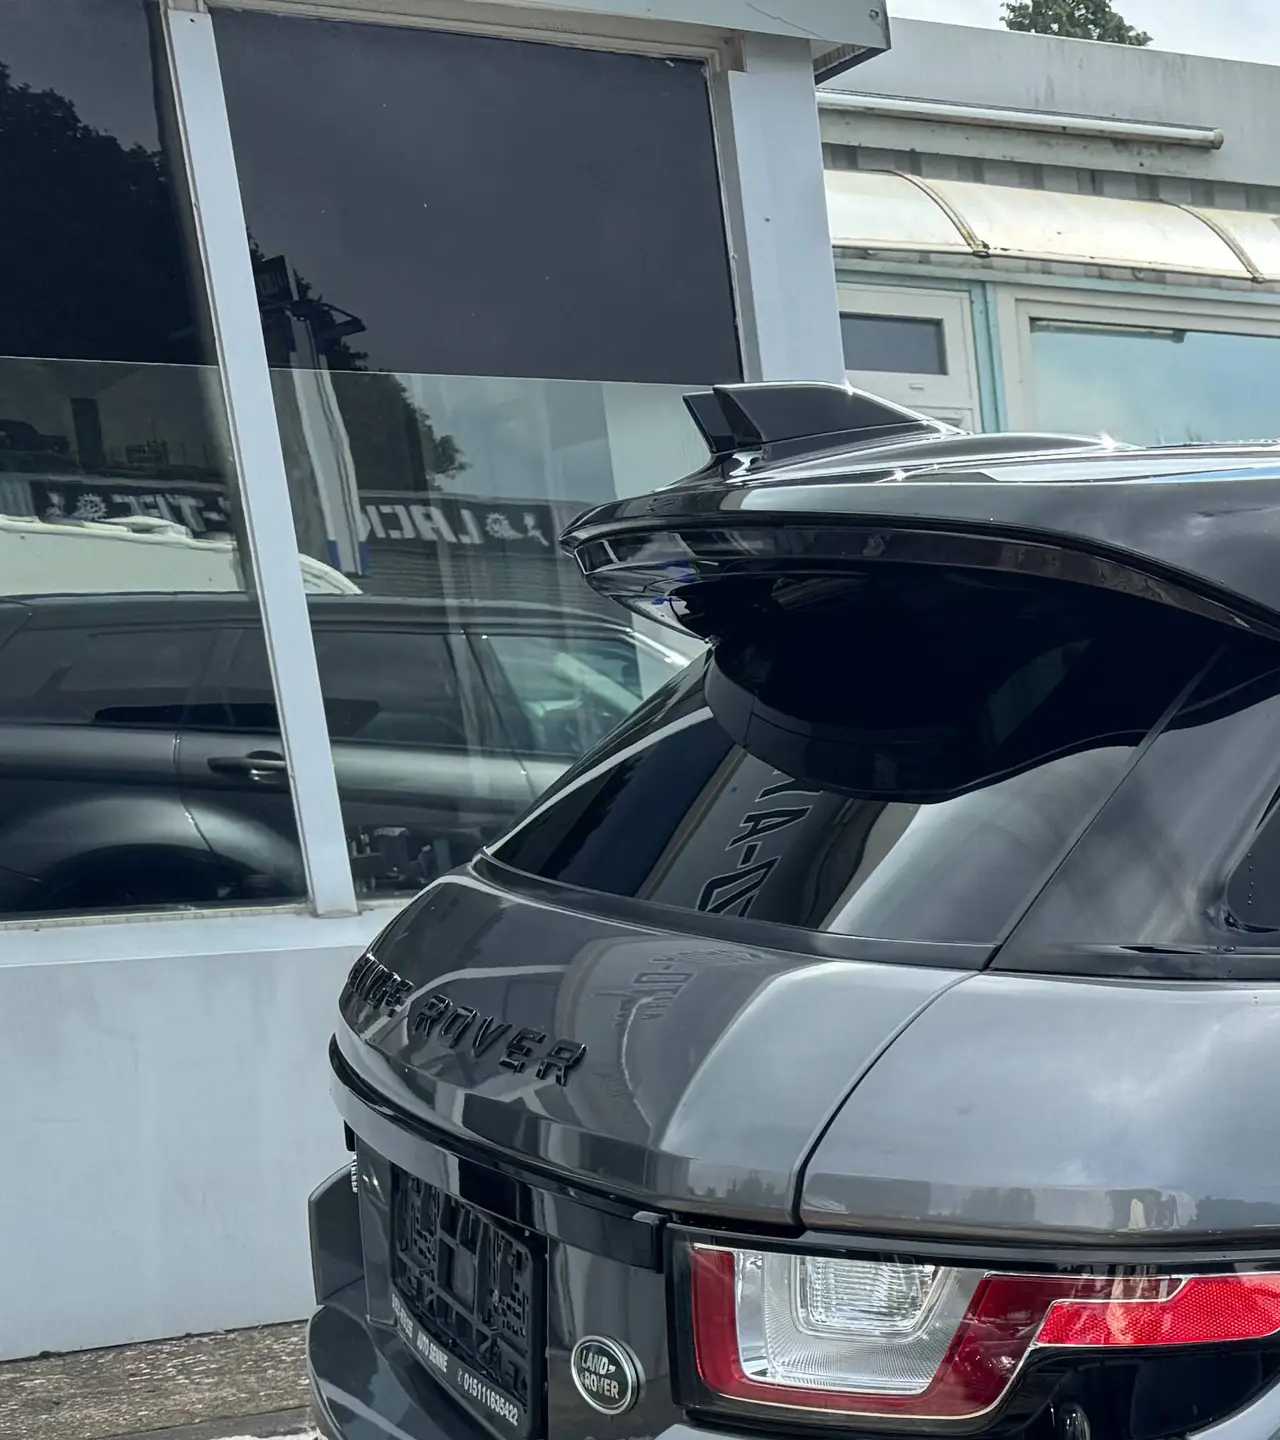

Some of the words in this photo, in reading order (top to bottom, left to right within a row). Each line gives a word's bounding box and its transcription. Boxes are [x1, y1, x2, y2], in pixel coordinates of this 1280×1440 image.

[413, 994, 588, 1087] ROVER
[581, 1349, 609, 1375] LAND
[463, 1372, 519, 1427] 015111635422
[584, 1371, 619, 1399] ROVER
